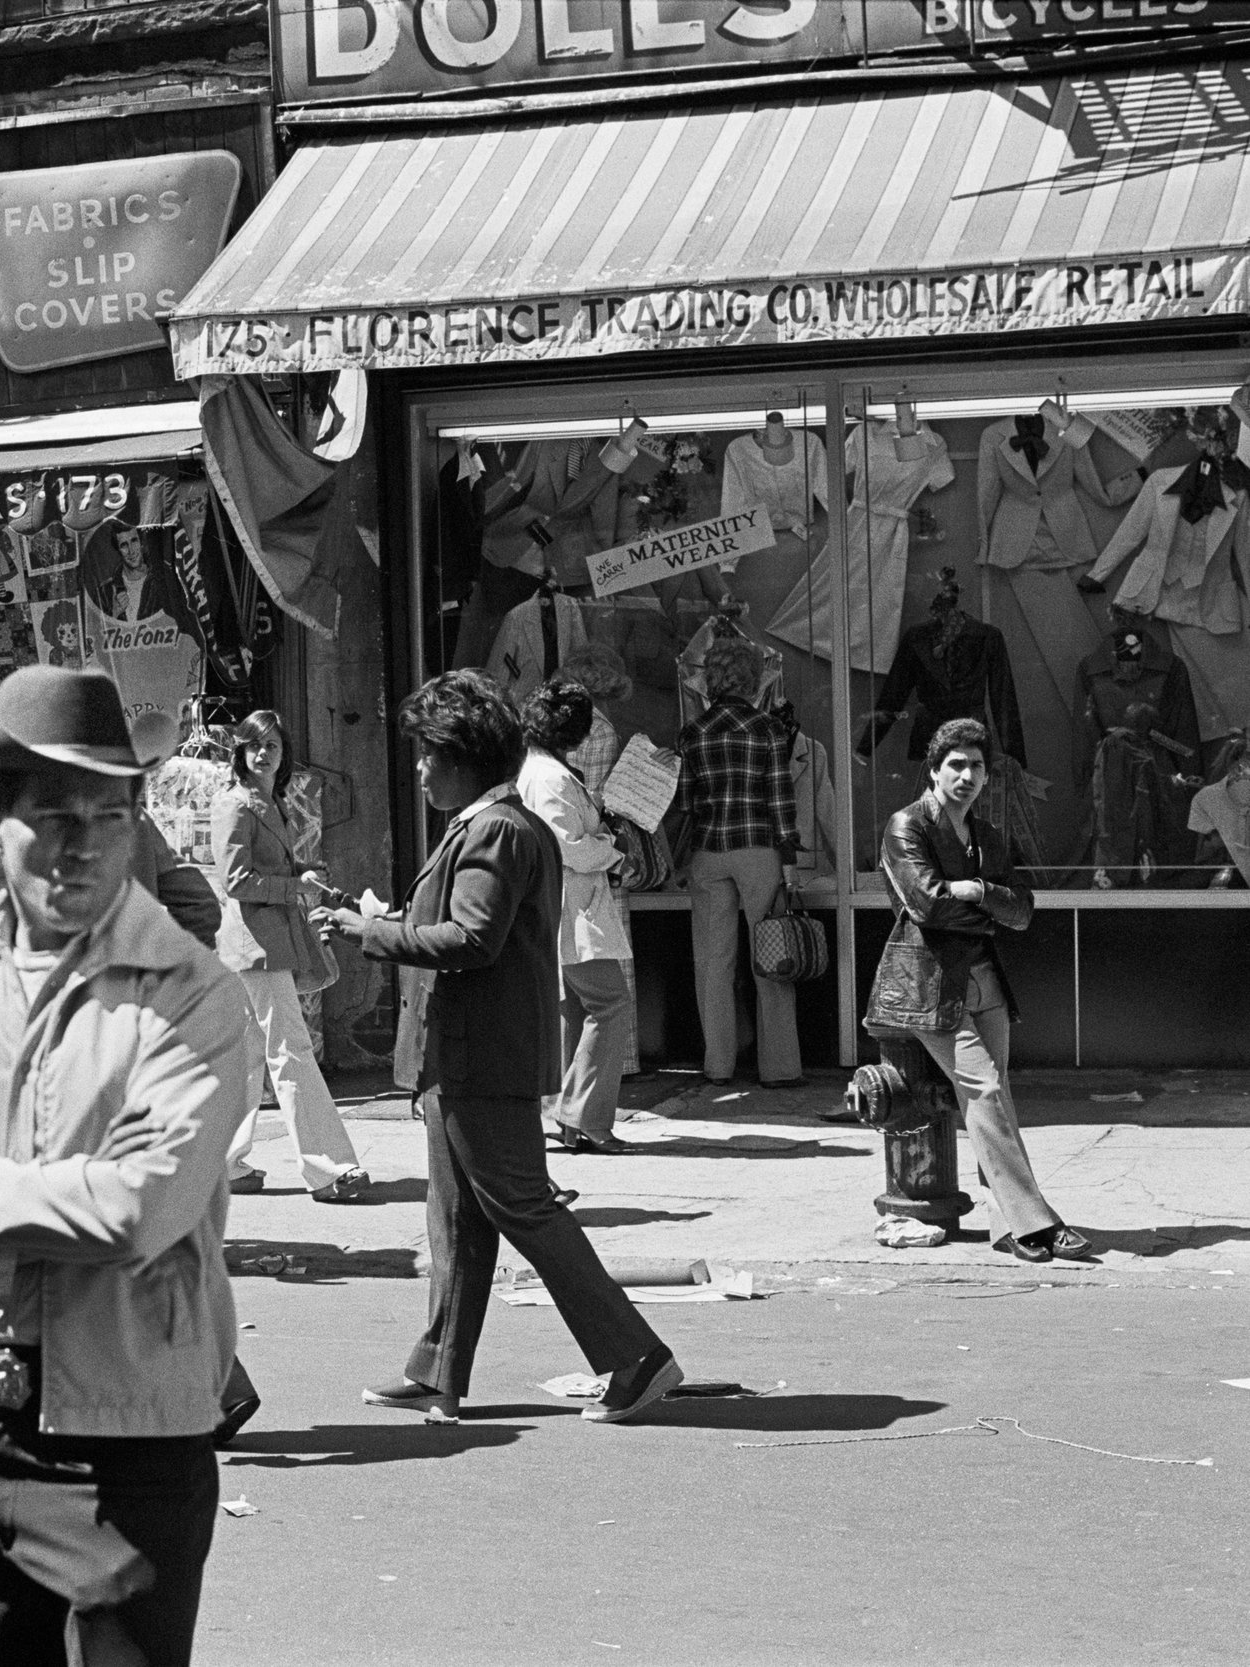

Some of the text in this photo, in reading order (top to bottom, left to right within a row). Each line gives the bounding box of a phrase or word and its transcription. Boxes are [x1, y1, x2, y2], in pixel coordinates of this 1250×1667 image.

[3, 190, 182, 236] FABRICS
[47, 251, 136, 288] SLIP
[14, 288, 178, 331] COVERS
[205, 257, 1205, 358] 175 FLORENCE TRADING CO. WHOLESALE RETAIL
[54, 473, 129, 513] 173
[626, 510, 758, 565] MATERNITY
[662, 537, 740, 569] WEAR
[595, 558, 613, 574] WE
[596, 562, 625, 587] CARRY
[103, 627, 132, 649] The
[134, 624, 179, 647] Fonz!
